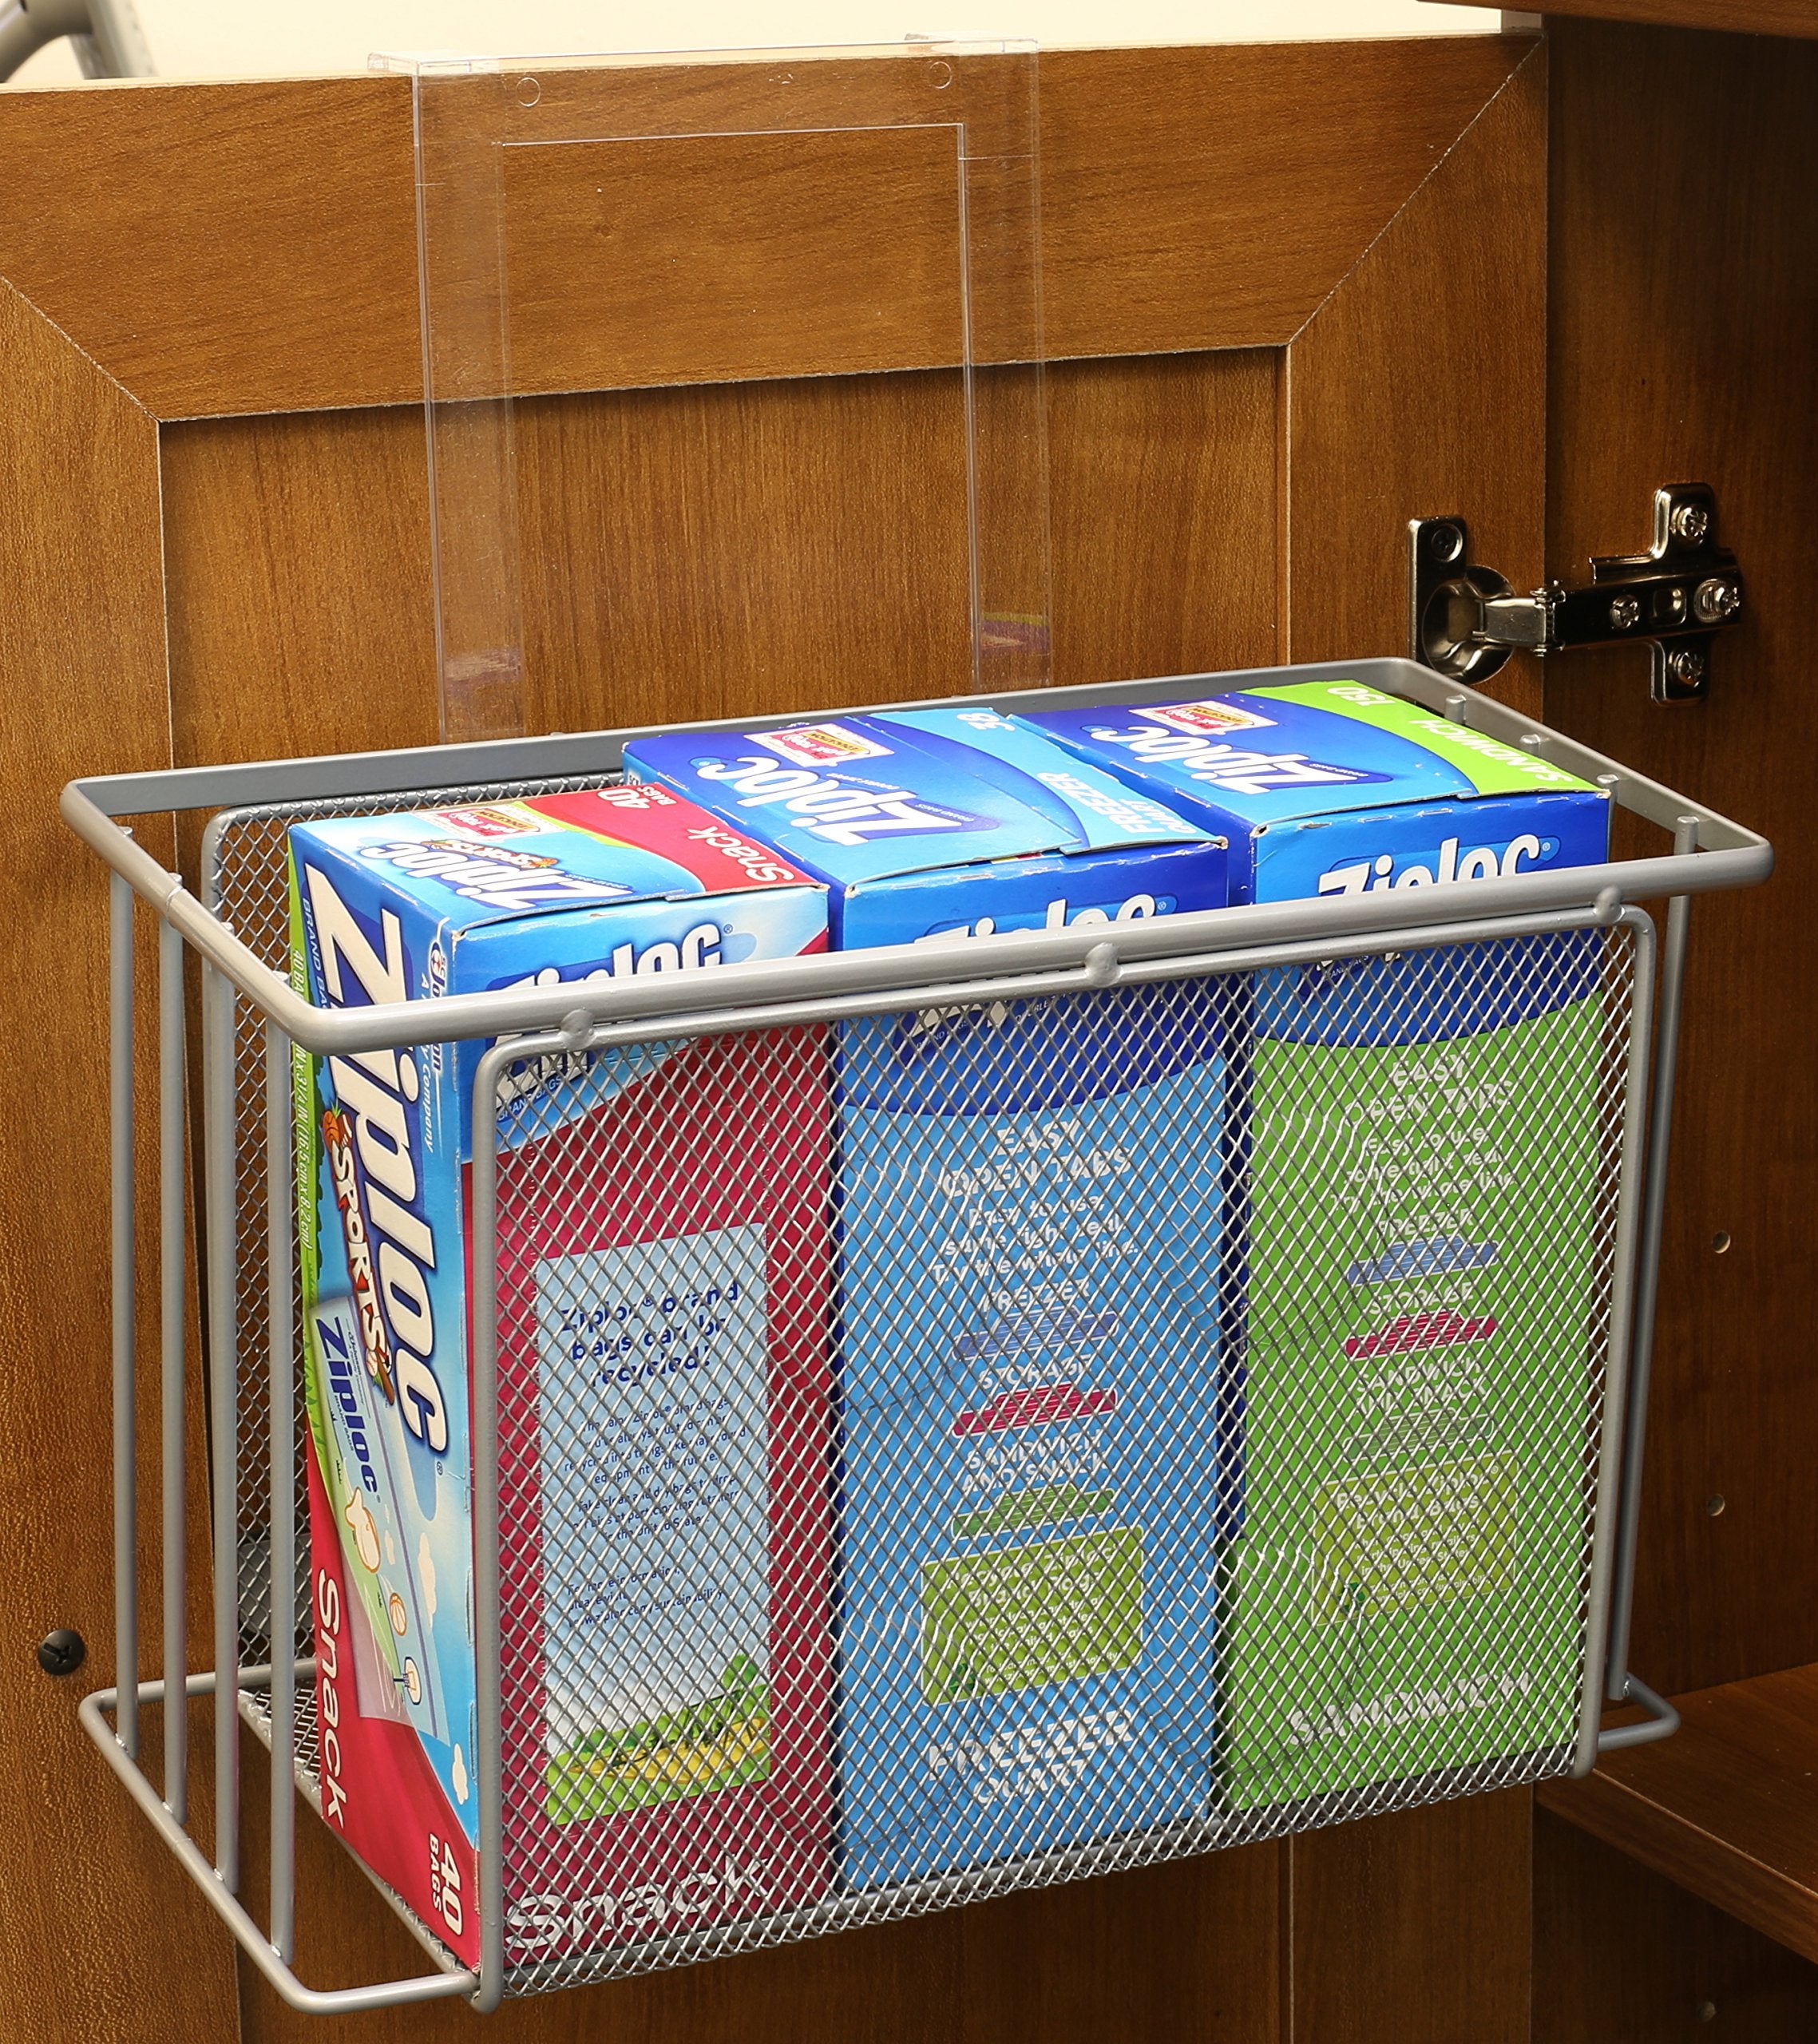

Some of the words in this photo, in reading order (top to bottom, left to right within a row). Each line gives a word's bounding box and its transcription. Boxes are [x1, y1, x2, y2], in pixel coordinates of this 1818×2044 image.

[1327, 687, 1396, 706] 150
[957, 712, 1016, 731] 38
[1091, 726, 1358, 795] Ziploc
[1408, 719, 1573, 782] SANDWICH
[597, 788, 651, 810] 40
[637, 786, 678, 806] BAGS
[696, 757, 962, 846] Ziploc
[1036, 772, 1166, 834] FREEZER
[1119, 798, 1197, 834] QUART
[359, 842, 634, 910] Ziploc
[686, 826, 795, 882] Snack
[302, 897, 322, 972] BRAND
[292, 950, 304, 970] 40
[1392, 1052, 1470, 1087] EASY
[421, 1063, 434, 1153] Company
[1344, 1091, 1429, 1127] OPEN
[1443, 1079, 1515, 1115] TABS
[304, 863, 447, 1452] Ziploc
[996, 1120, 1079, 1155] EASY
[942, 1160, 1038, 1198] OPEN
[1052, 1148, 1131, 1183] TABS
[968, 1206, 1020, 1226] Easy
[1029, 1198, 1052, 1218] to
[1376, 1206, 1475, 1238] FREEZER
[331, 1140, 386, 1351] SPORTS
[561, 1299, 640, 1333] Ziploc
[661, 1280, 739, 1314] brand
[984, 1278, 1091, 1312] FREEZER
[1369, 1281, 1475, 1314] STORAGE
[572, 1333, 634, 1361] bags
[644, 1326, 688, 1348] can
[698, 1313, 730, 1337] be
[590, 1344, 711, 1388] recycled!
[978, 1353, 1092, 1390] STORAGE
[1357, 1357, 1481, 1393] SANDWICH
[316, 1316, 378, 1492] Ziploc
[632, 1409, 666, 1424] Zipoc
[656, 1419, 693, 1436] tusted
[564, 1456, 609, 1472] reycld
[967, 1428, 1102, 1470] SANDWICH
[595, 1465, 650, 1485] eqpmnt
[319, 1568, 347, 1830] Snack
[1290, 1671, 1529, 1745] SANDWICH
[928, 1710, 1133, 1781] FREEZER
[429, 1833, 442, 1912] BAGS
[440, 1840, 464, 1937] 40
[505, 1853, 769, 1948] Snack
